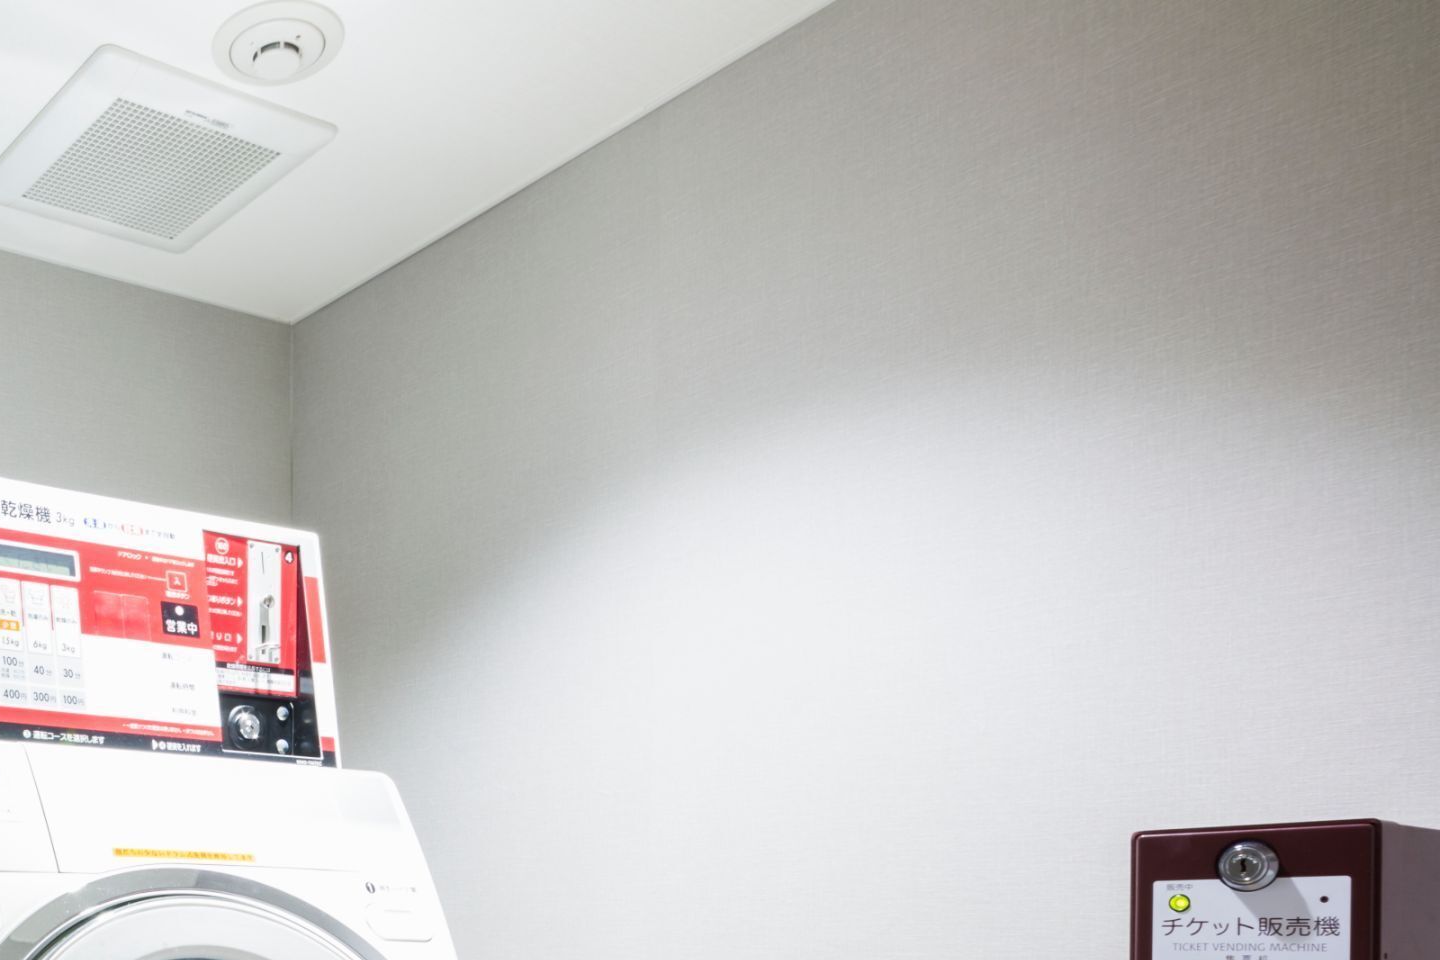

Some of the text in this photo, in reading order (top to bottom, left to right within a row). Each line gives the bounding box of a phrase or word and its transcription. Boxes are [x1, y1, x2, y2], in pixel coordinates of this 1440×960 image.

[55, 512, 75, 527] 3kg
[165, 619, 198, 636] 営業中
[1161, 916, 1341, 937] チケット販売機
[1173, 943, 1328, 952] TICKET VENDING MACHINE
